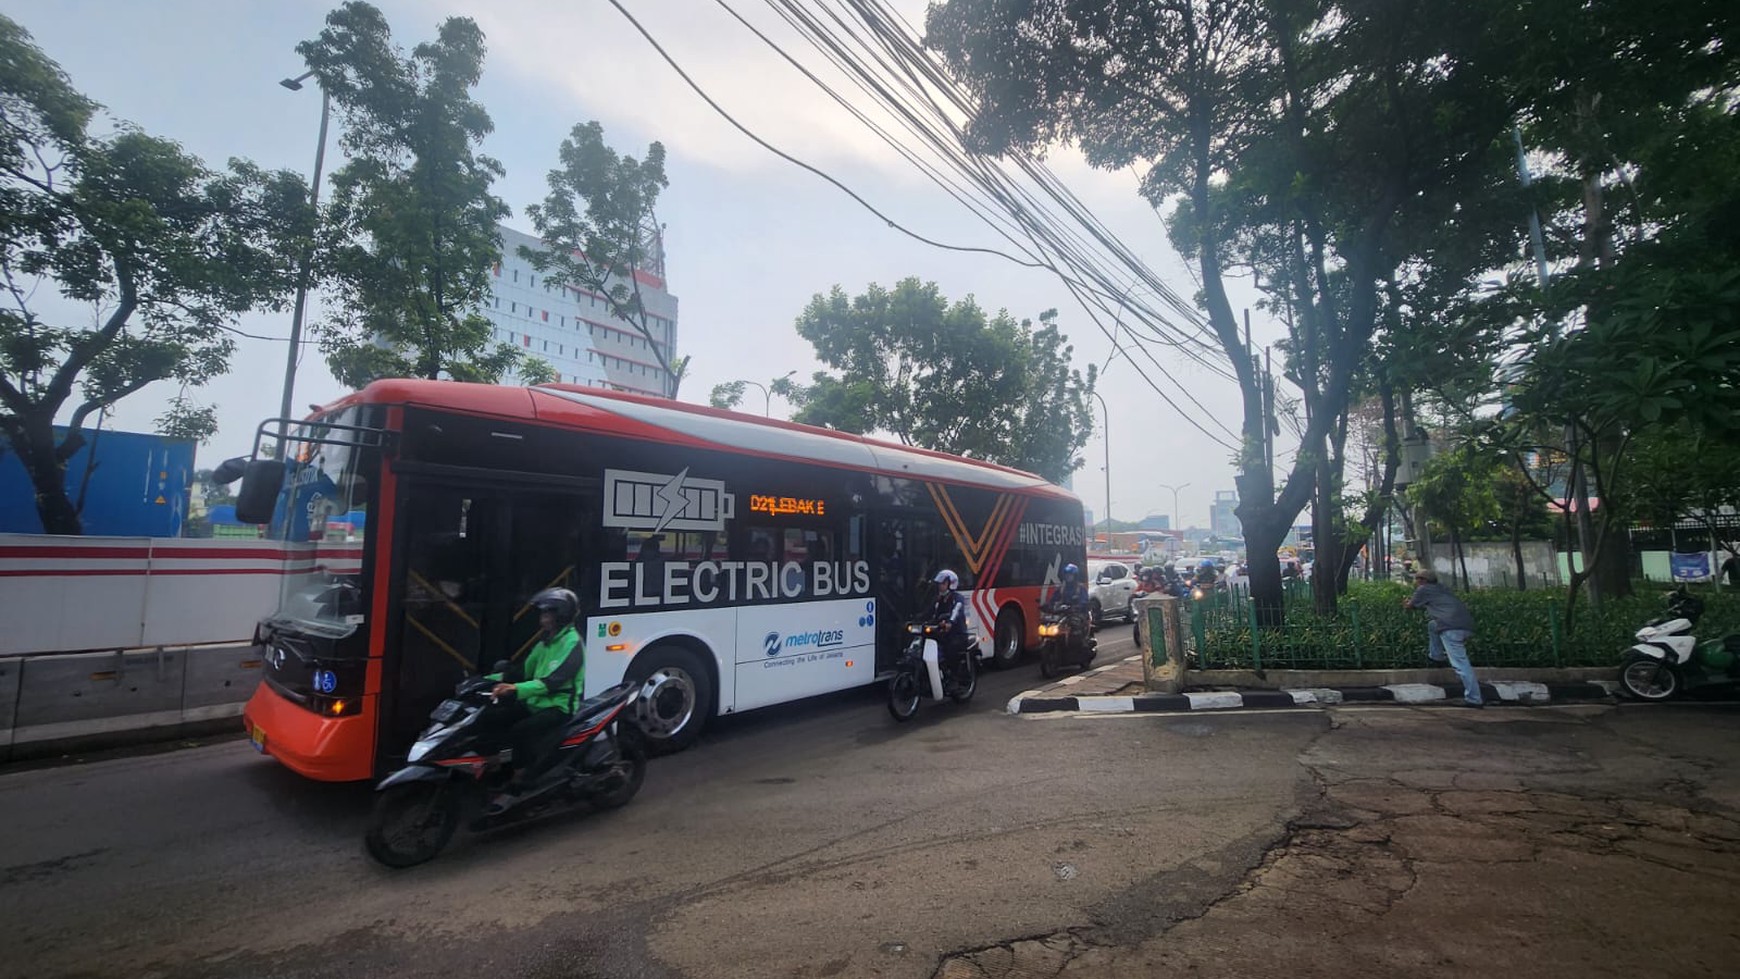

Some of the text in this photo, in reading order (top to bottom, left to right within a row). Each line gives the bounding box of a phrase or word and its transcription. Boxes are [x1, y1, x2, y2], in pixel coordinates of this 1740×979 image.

[600, 560, 870, 608] ELECTRIC BUS
[785, 629, 844, 647] metrotrans
